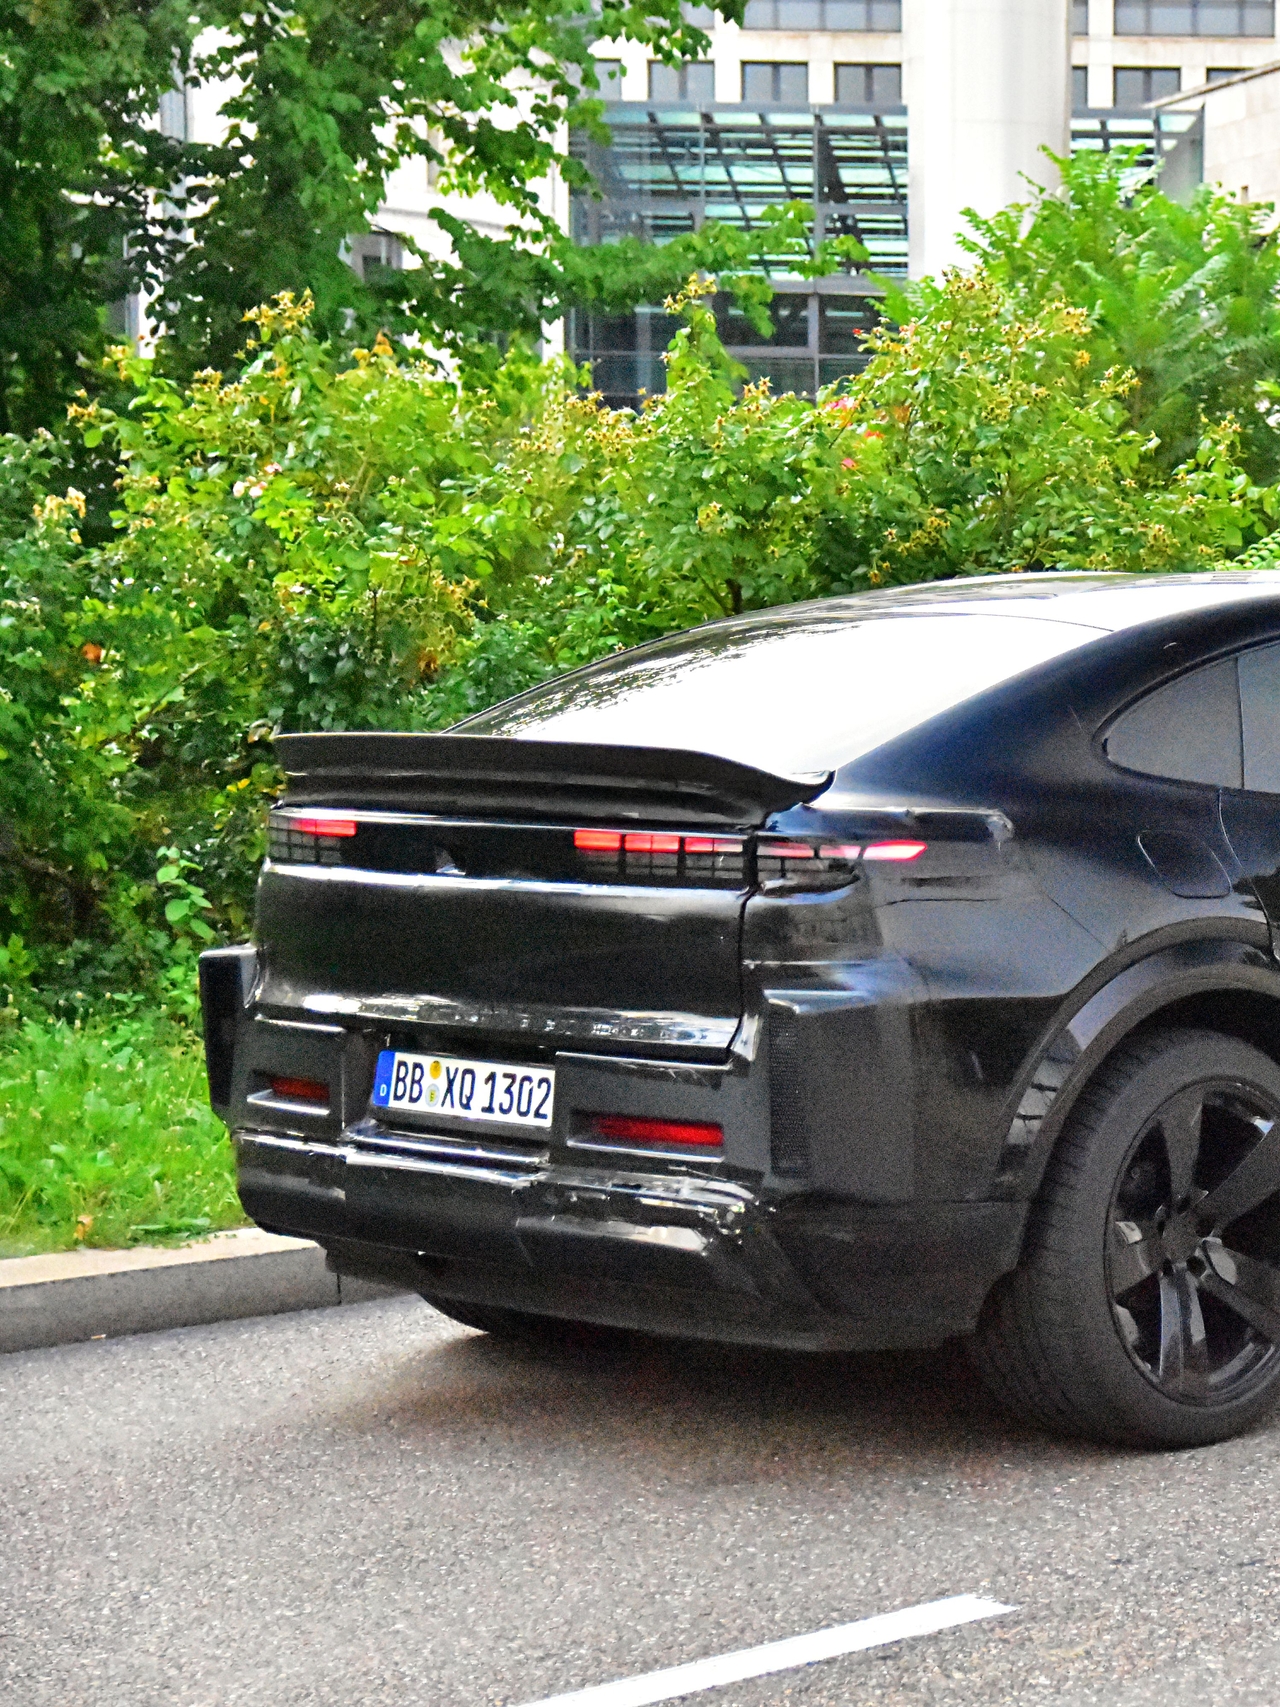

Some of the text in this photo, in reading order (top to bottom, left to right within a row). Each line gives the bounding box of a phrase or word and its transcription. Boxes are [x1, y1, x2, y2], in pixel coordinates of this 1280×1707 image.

[393, 1060, 551, 1119] BB XQ 1302
